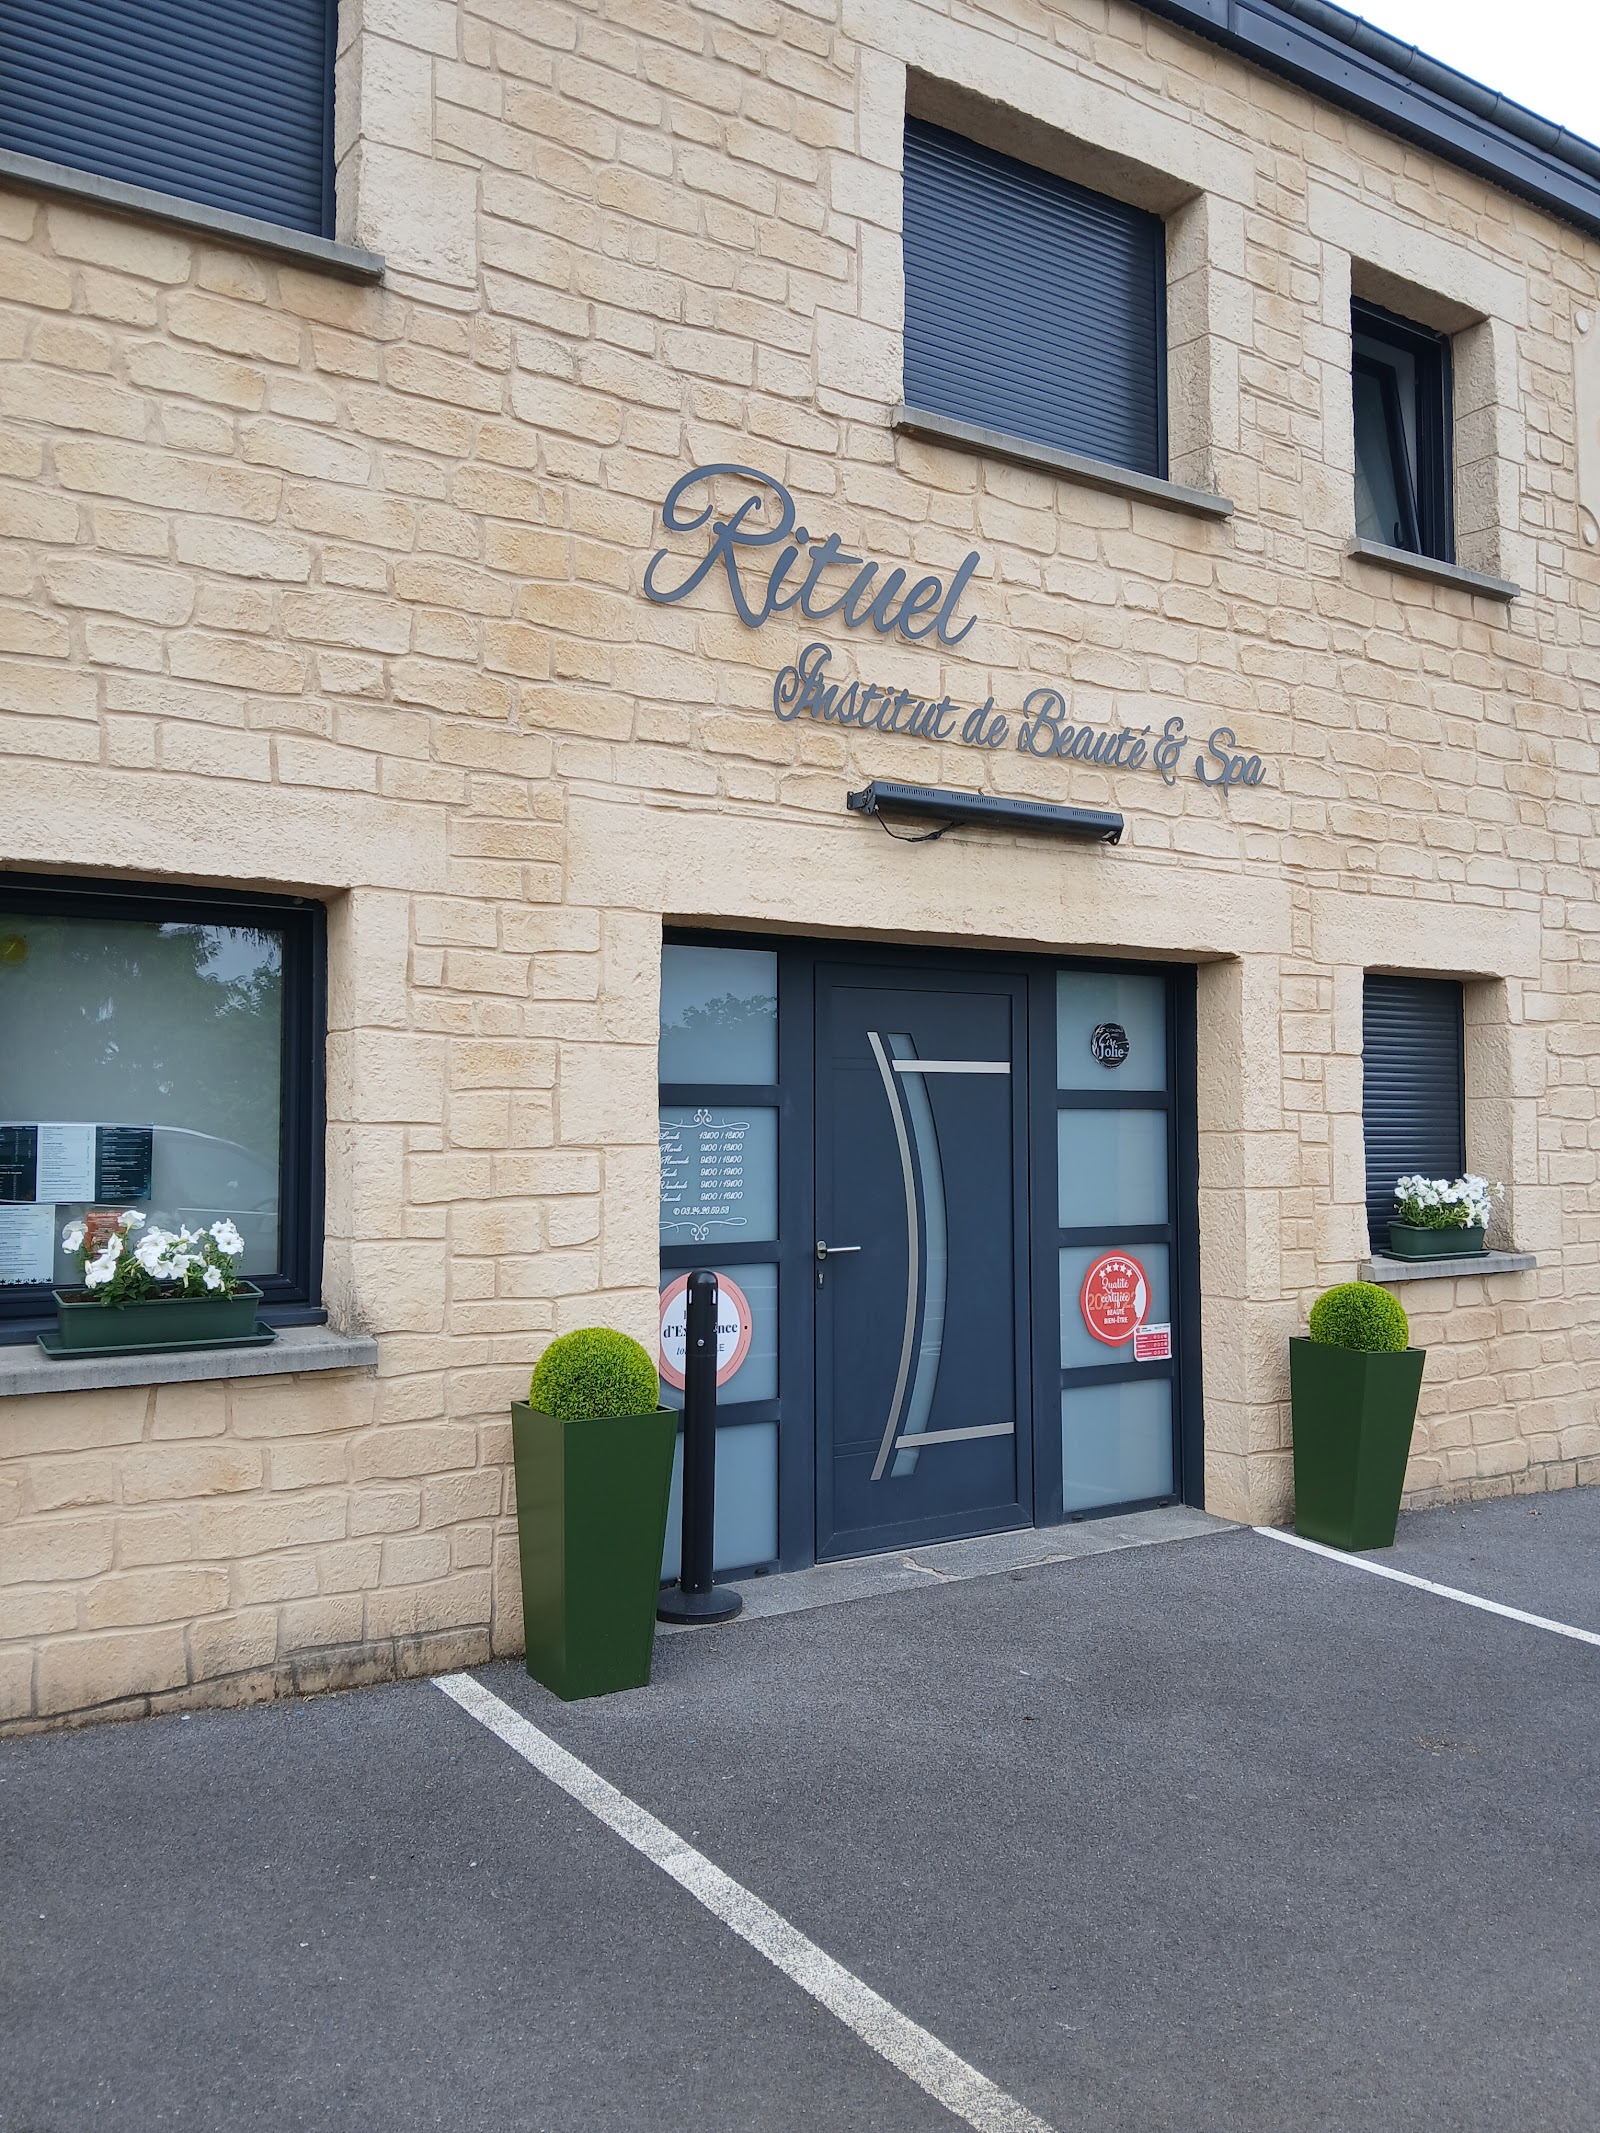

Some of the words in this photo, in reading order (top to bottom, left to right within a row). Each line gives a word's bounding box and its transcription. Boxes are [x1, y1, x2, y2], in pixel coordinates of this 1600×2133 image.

[644, 463, 980, 645] Rituel
[774, 642, 959, 738] Institut
[962, 697, 1009, 749] de
[1018, 688, 1151, 771] Beauté
[1153, 717, 1188, 786] &
[1196, 727, 1267, 797] Spa
[1099, 1043, 1124, 1059] Jolie
[1102, 1277, 1129, 1294] Qualité
